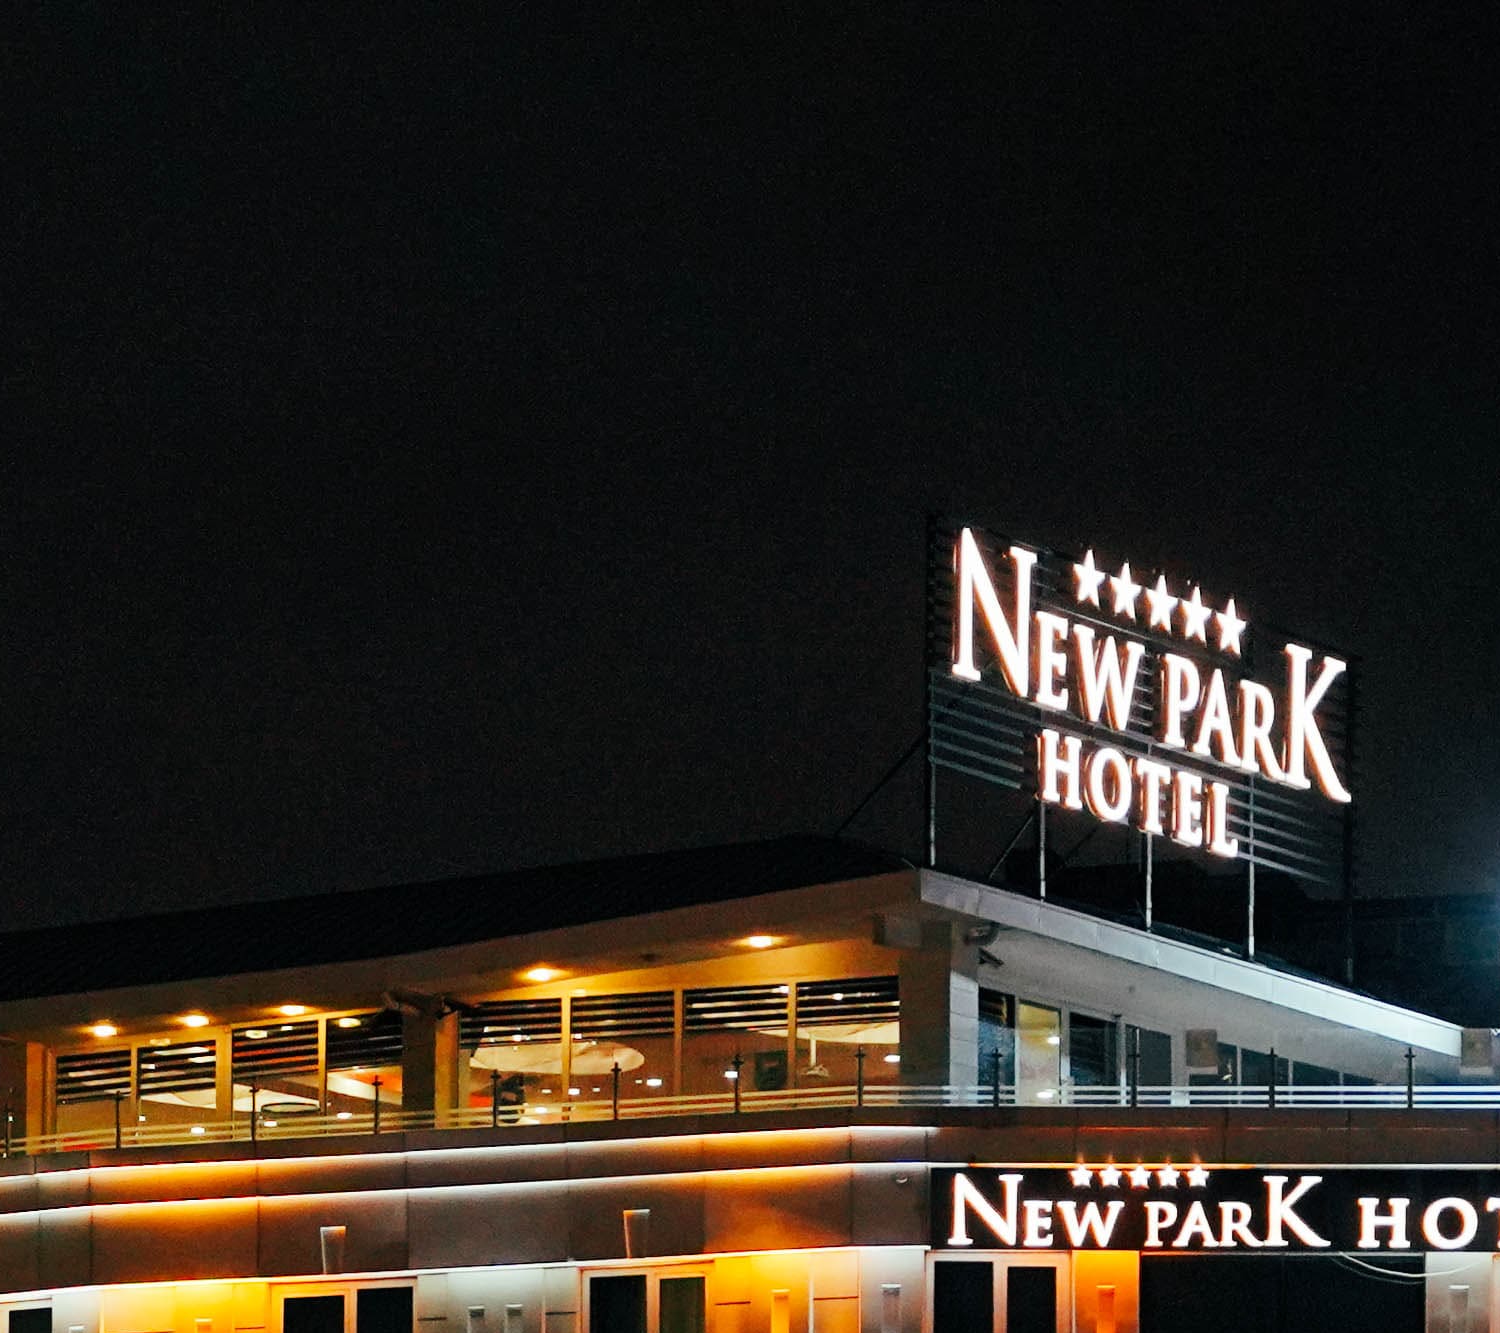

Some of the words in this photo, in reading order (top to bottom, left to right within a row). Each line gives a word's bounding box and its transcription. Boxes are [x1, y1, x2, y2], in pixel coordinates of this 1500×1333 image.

[952, 527, 1146, 732] NEW
[1155, 642, 1352, 803] PARK
[1038, 728, 1239, 858] HOTEL
[947, 1172, 1125, 1248] NEW
[1144, 1175, 1331, 1248] PARK
